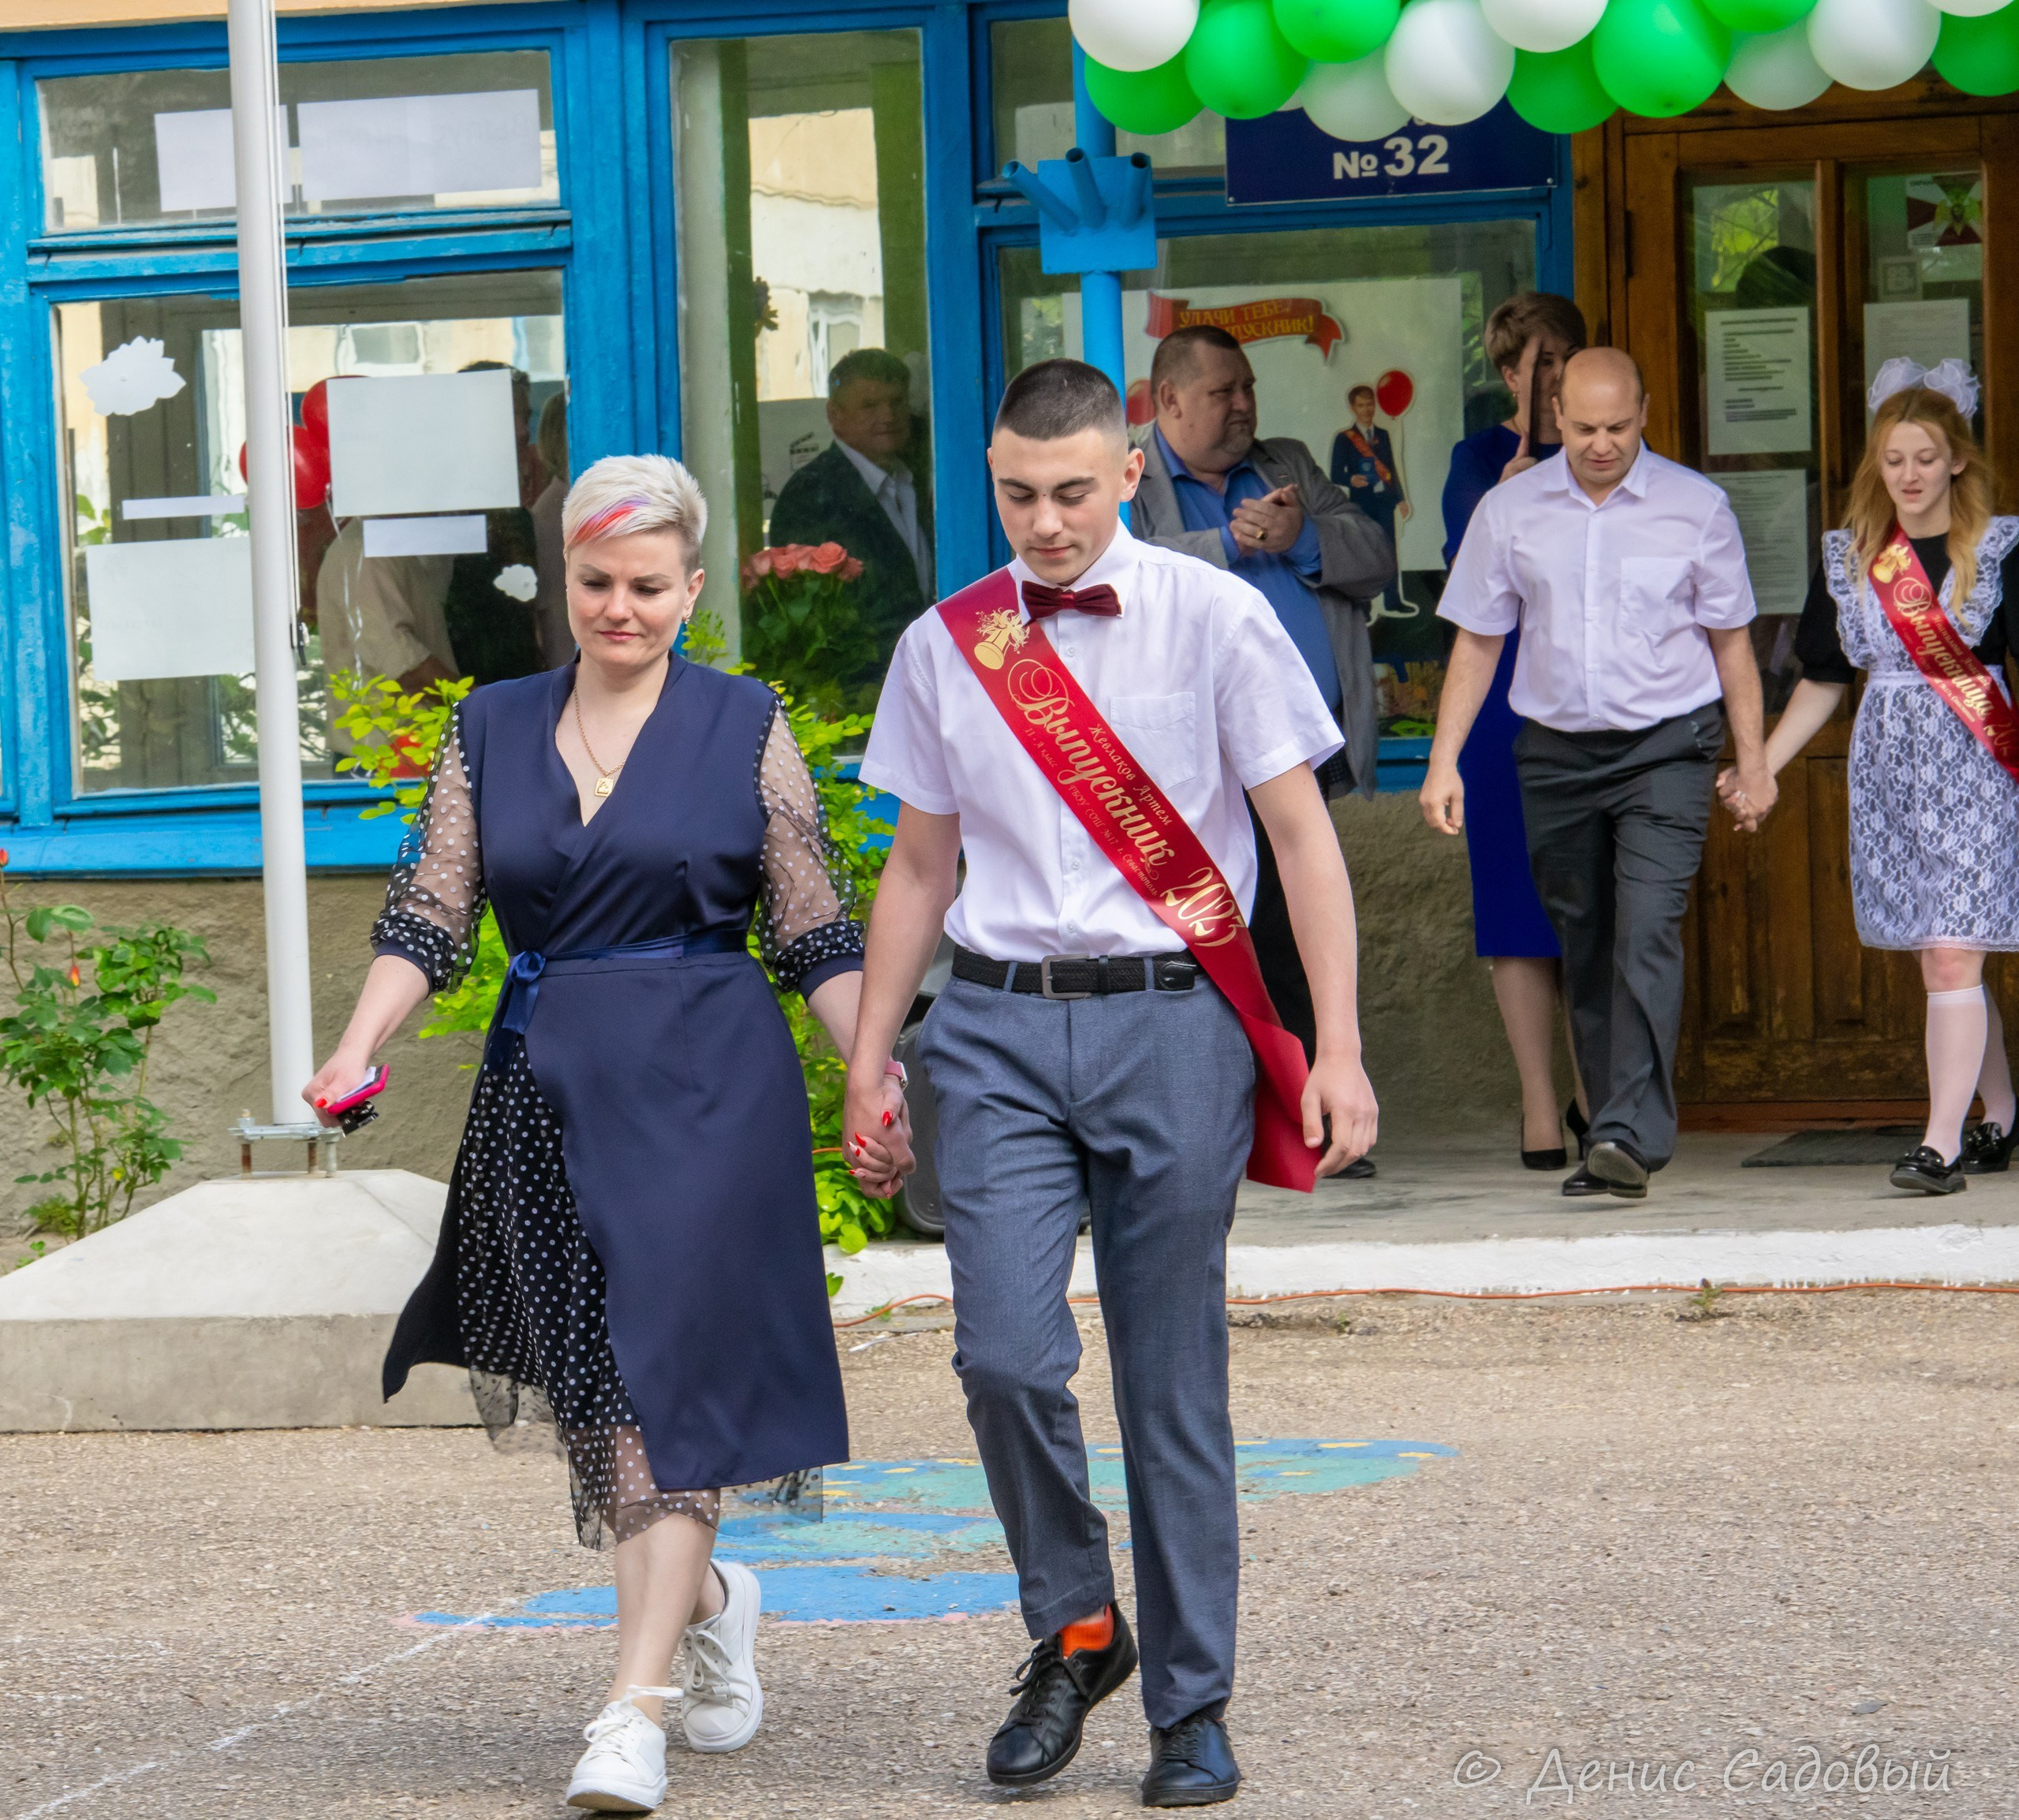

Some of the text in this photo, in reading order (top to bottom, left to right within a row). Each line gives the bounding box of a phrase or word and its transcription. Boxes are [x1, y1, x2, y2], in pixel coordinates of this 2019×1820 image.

[1179, 310, 1236, 327] УДАЧИ
[1226, 314, 1315, 340] ПУСКНИК!
[1894, 576, 1995, 721] Выпускница
[1008, 658, 1176, 880] Выпускник
[1088, 724, 1174, 826] Жевлаков Артем
[1084, 808, 1106, 828] СОШ
[1122, 853, 1159, 897] Севастополь
[1159, 867, 1248, 947] 2023
